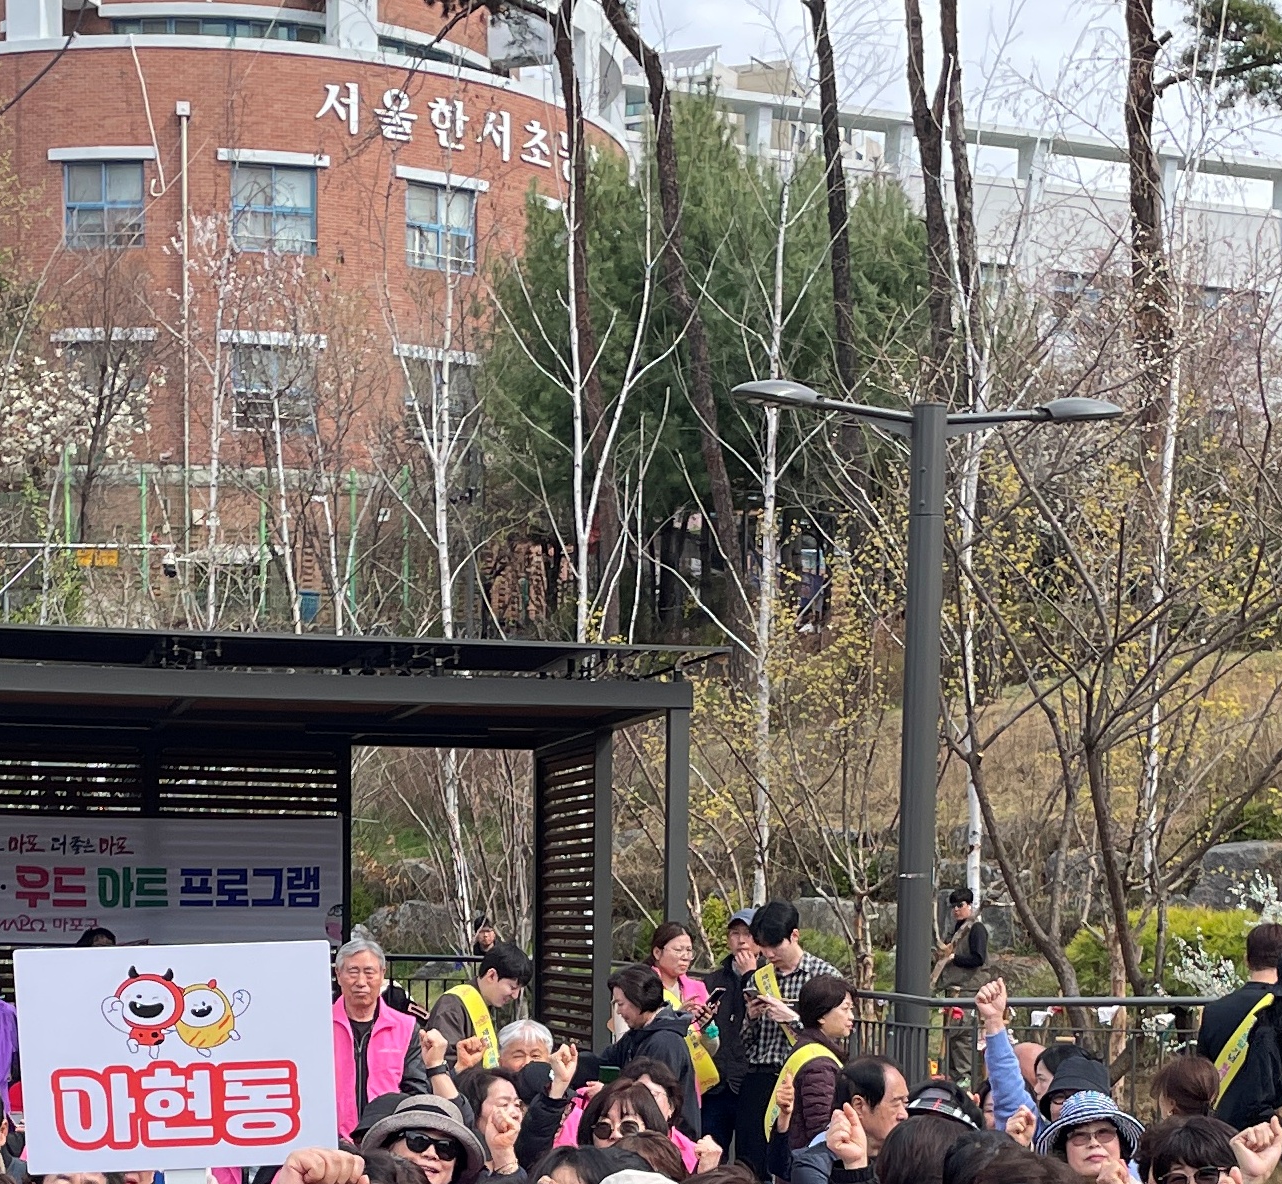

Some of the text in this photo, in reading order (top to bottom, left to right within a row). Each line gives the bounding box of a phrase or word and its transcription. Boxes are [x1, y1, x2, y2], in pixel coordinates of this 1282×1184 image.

[9, 834, 45, 854] 마포
[50, 835, 67, 855] 더
[70, 836, 97, 855] 좋은
[99, 836, 134, 856] 마포
[98, 866, 169, 908] 아트
[179, 866, 320, 908] 프로그램
[53, 1062, 298, 1149] 아현동
